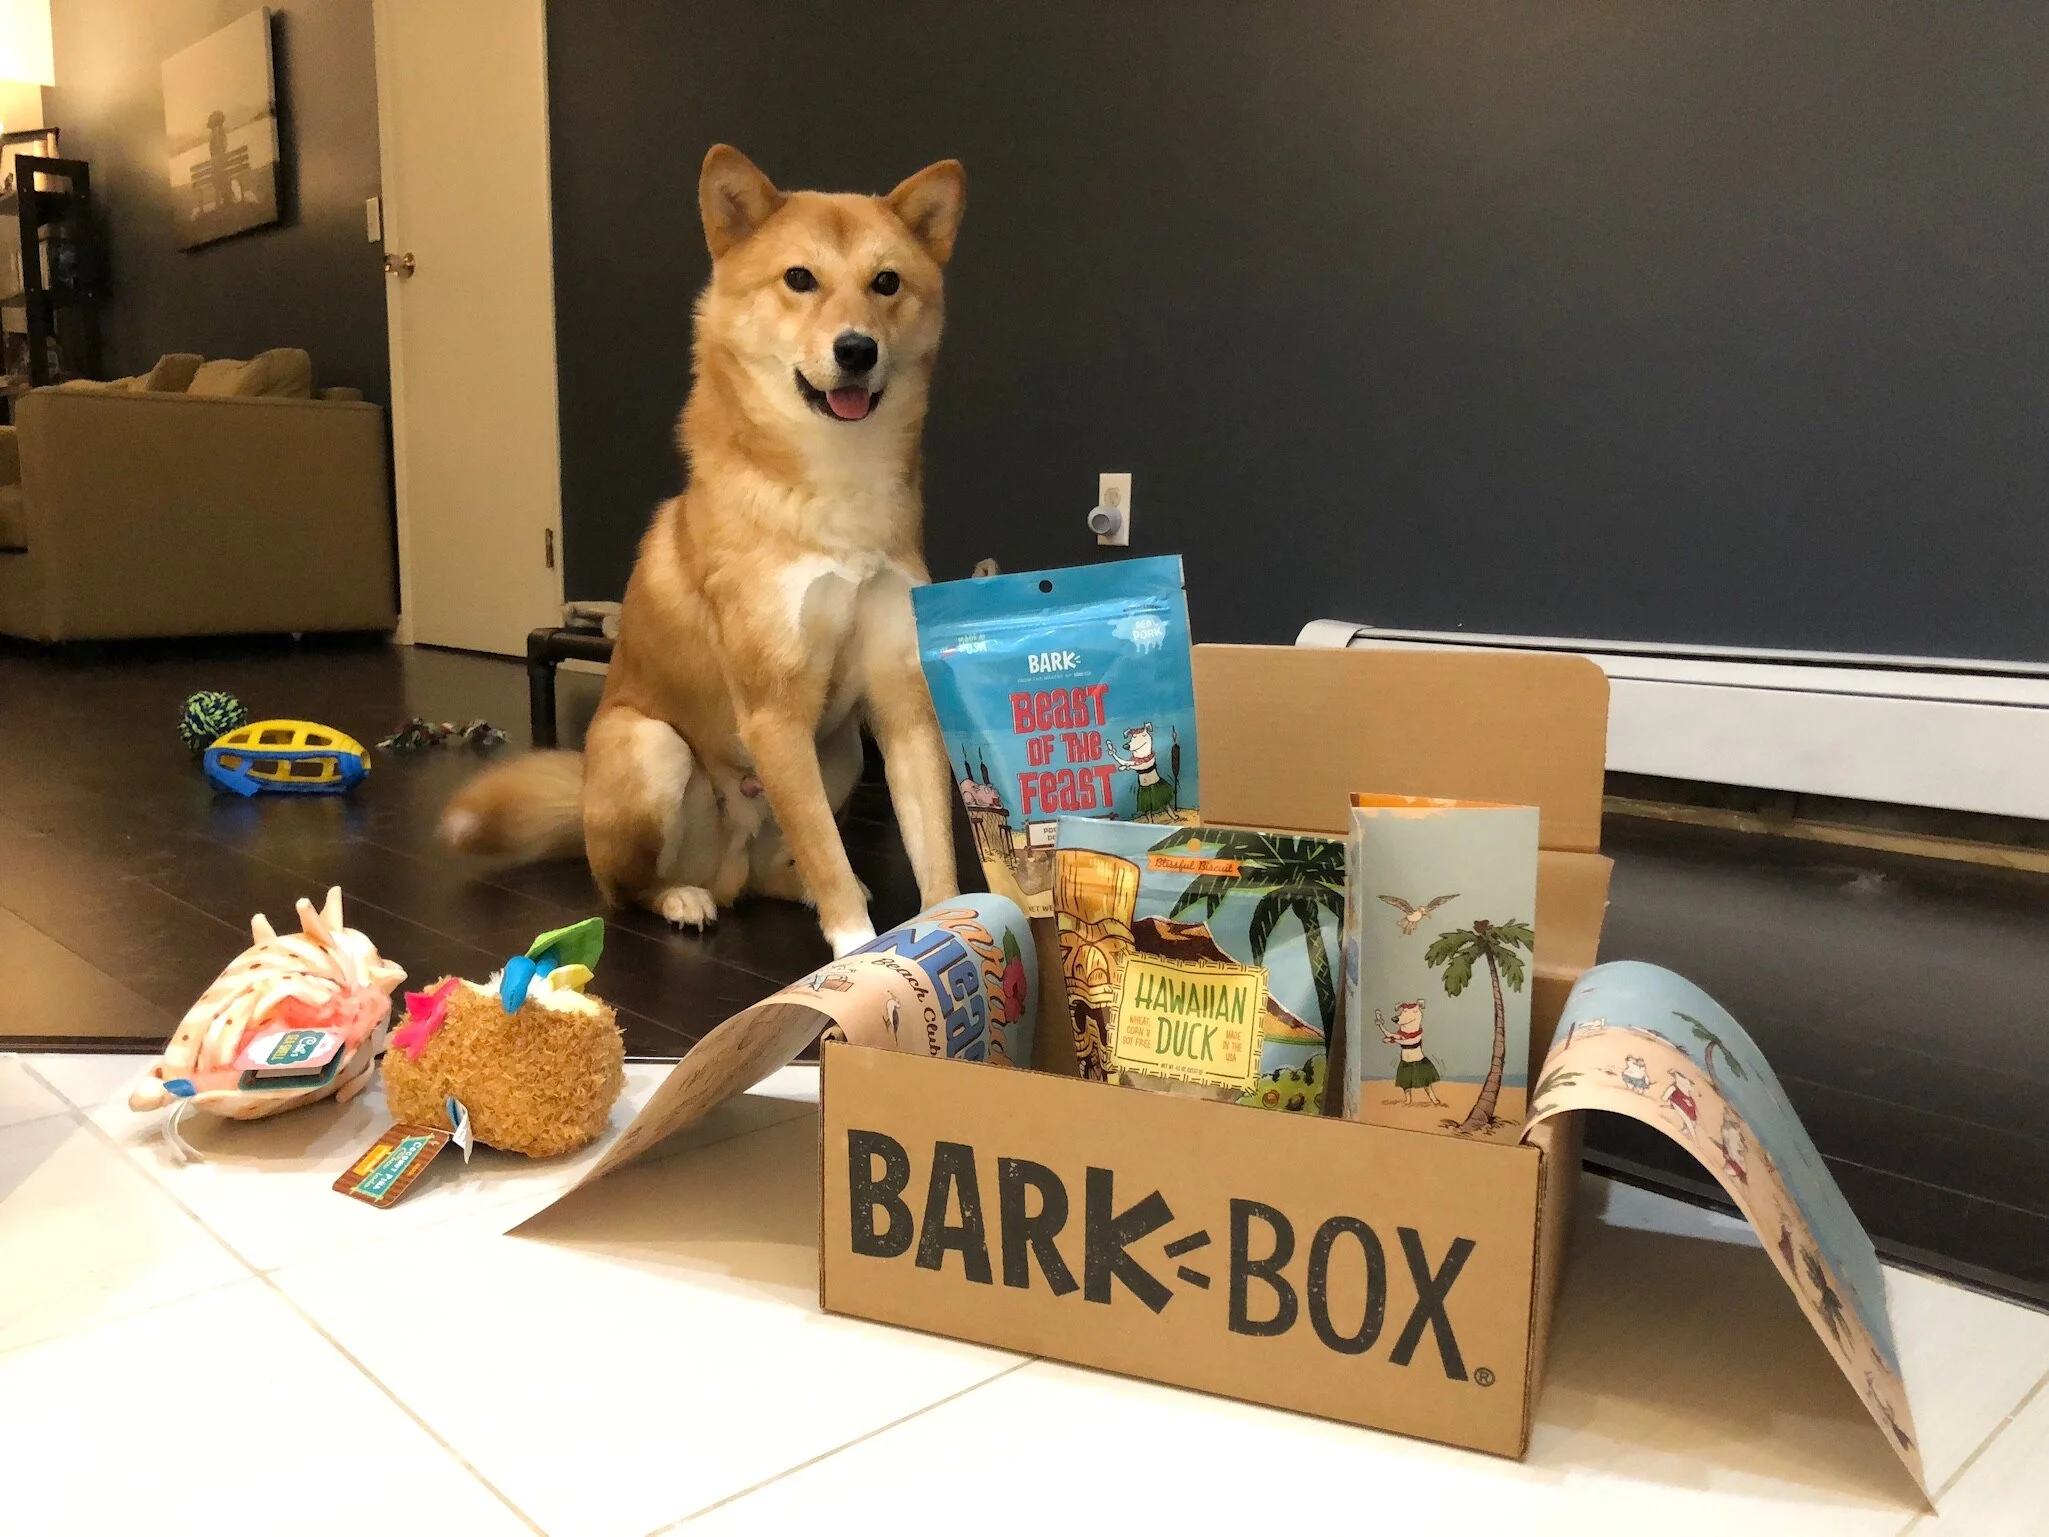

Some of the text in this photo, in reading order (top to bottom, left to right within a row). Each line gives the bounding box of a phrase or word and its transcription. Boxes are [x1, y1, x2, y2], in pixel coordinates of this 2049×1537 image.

[1132, 626, 1164, 641] PORK
[1136, 619, 1160, 630] REAL
[1027, 650, 1077, 674] BARK
[1026, 734, 1055, 766] OF
[1154, 857, 1234, 873] Blissful Biscuit
[871, 957, 942, 1057] Beach Club
[1134, 972, 1247, 1024] HAWAIIAN
[1135, 1037, 1151, 1049] FREE
[1155, 1016, 1218, 1061] DUCK
[847, 1129, 1175, 1315] BARK
[1228, 1198, 1477, 1382] BOX
